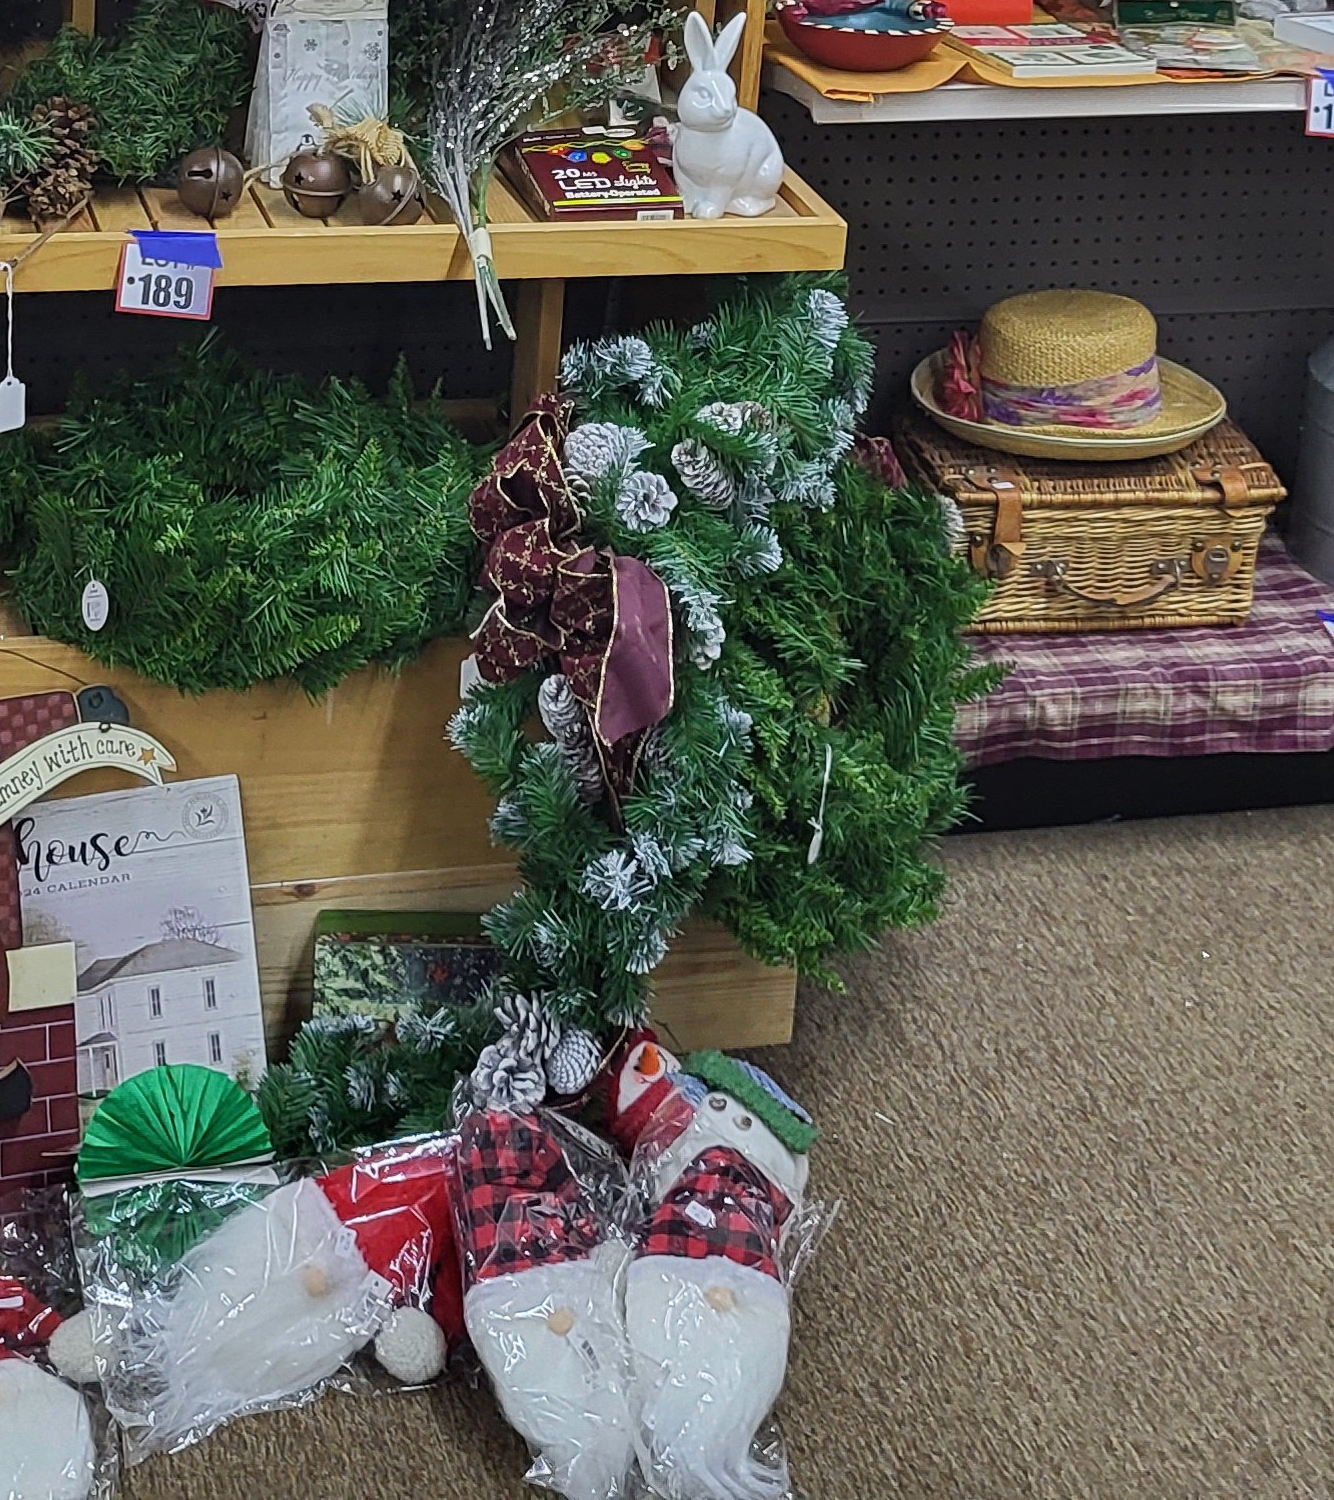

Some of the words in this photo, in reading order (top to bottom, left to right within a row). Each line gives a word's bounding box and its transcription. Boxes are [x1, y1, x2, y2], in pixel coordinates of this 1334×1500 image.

[551, 168, 581, 180] 20
[558, 177, 612, 190] LED
[138, 273, 194, 310] 189
[46, 734, 94, 773] with
[97, 737, 137, 758] care
[19, 888, 42, 897] 24
[46, 873, 132, 894] CALENDAR
